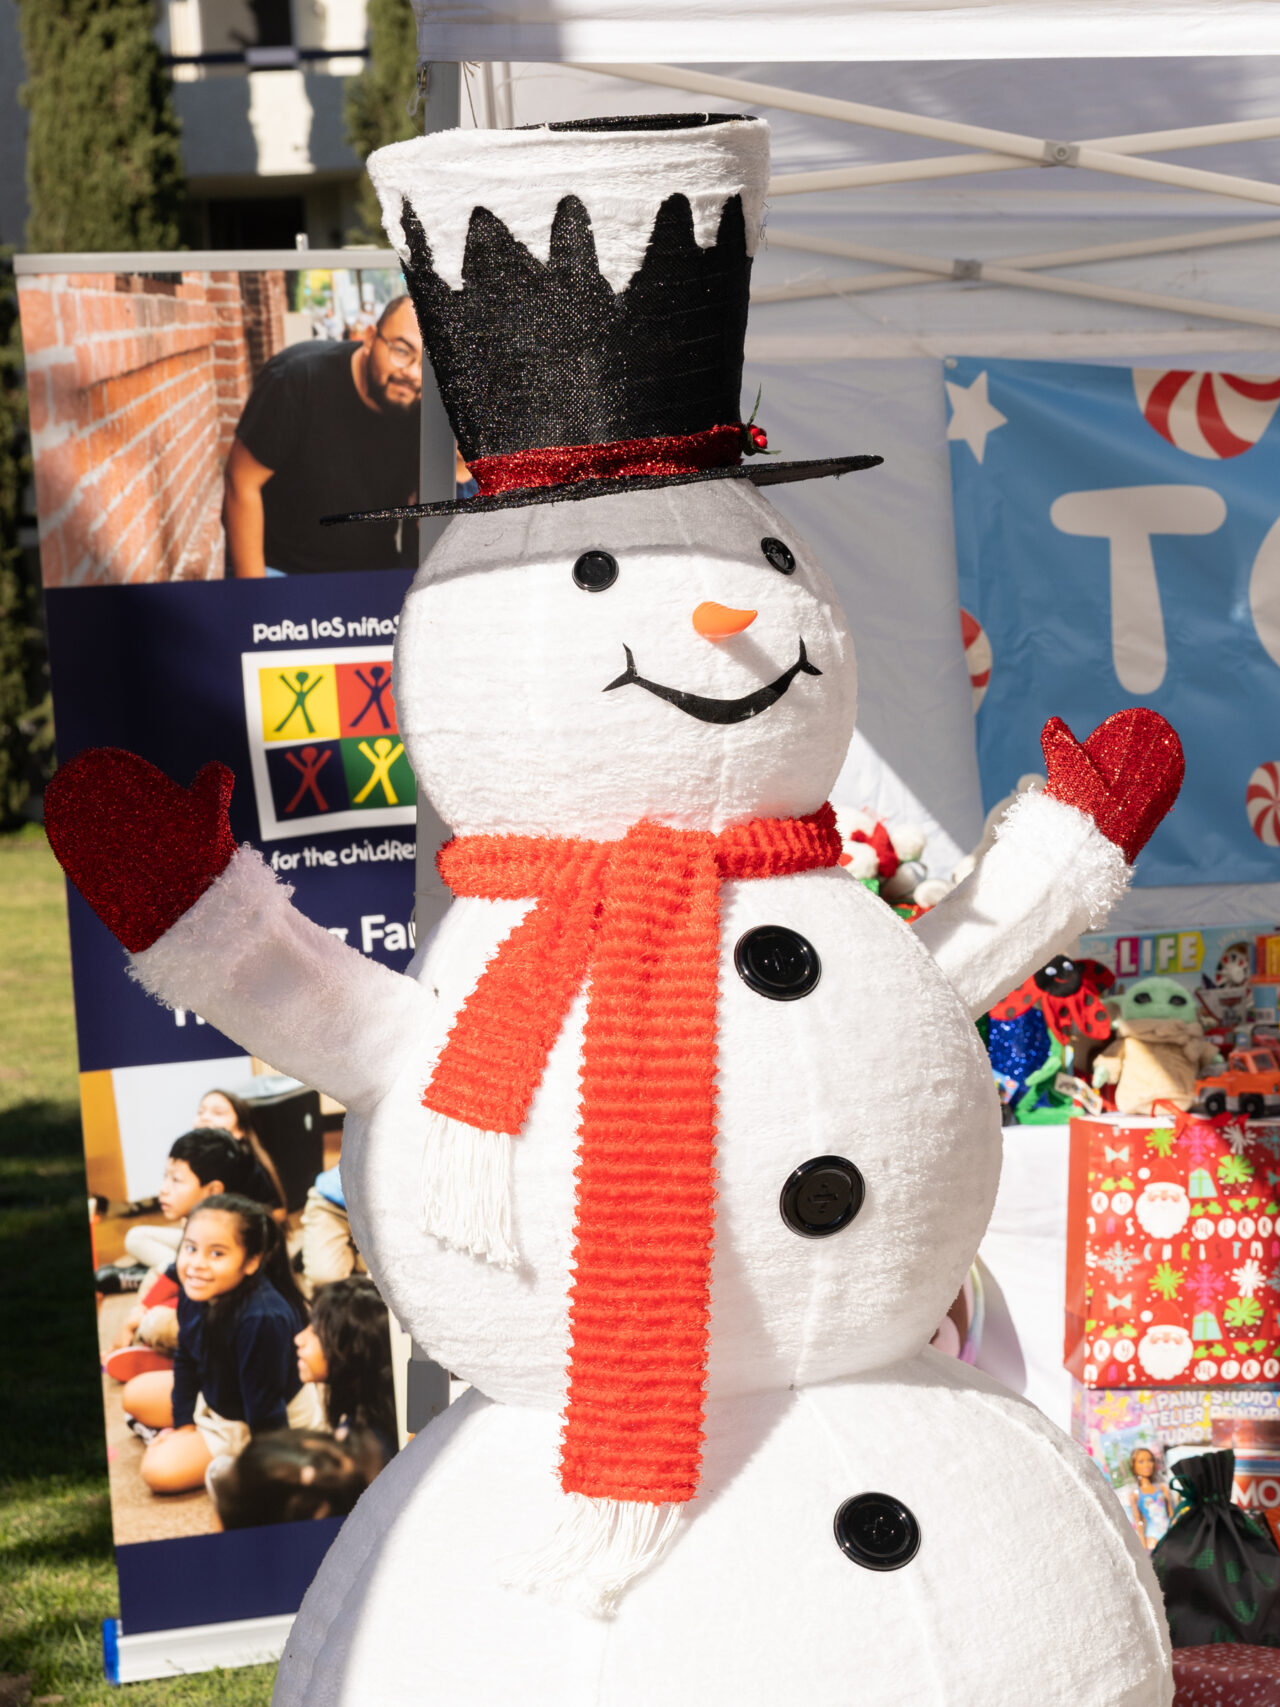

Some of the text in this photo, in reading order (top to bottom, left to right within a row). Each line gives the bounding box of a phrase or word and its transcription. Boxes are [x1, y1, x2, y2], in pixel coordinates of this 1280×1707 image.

[271, 850, 301, 872] for
[303, 845, 339, 868] the
[1119, 935, 1199, 975] LIFE
